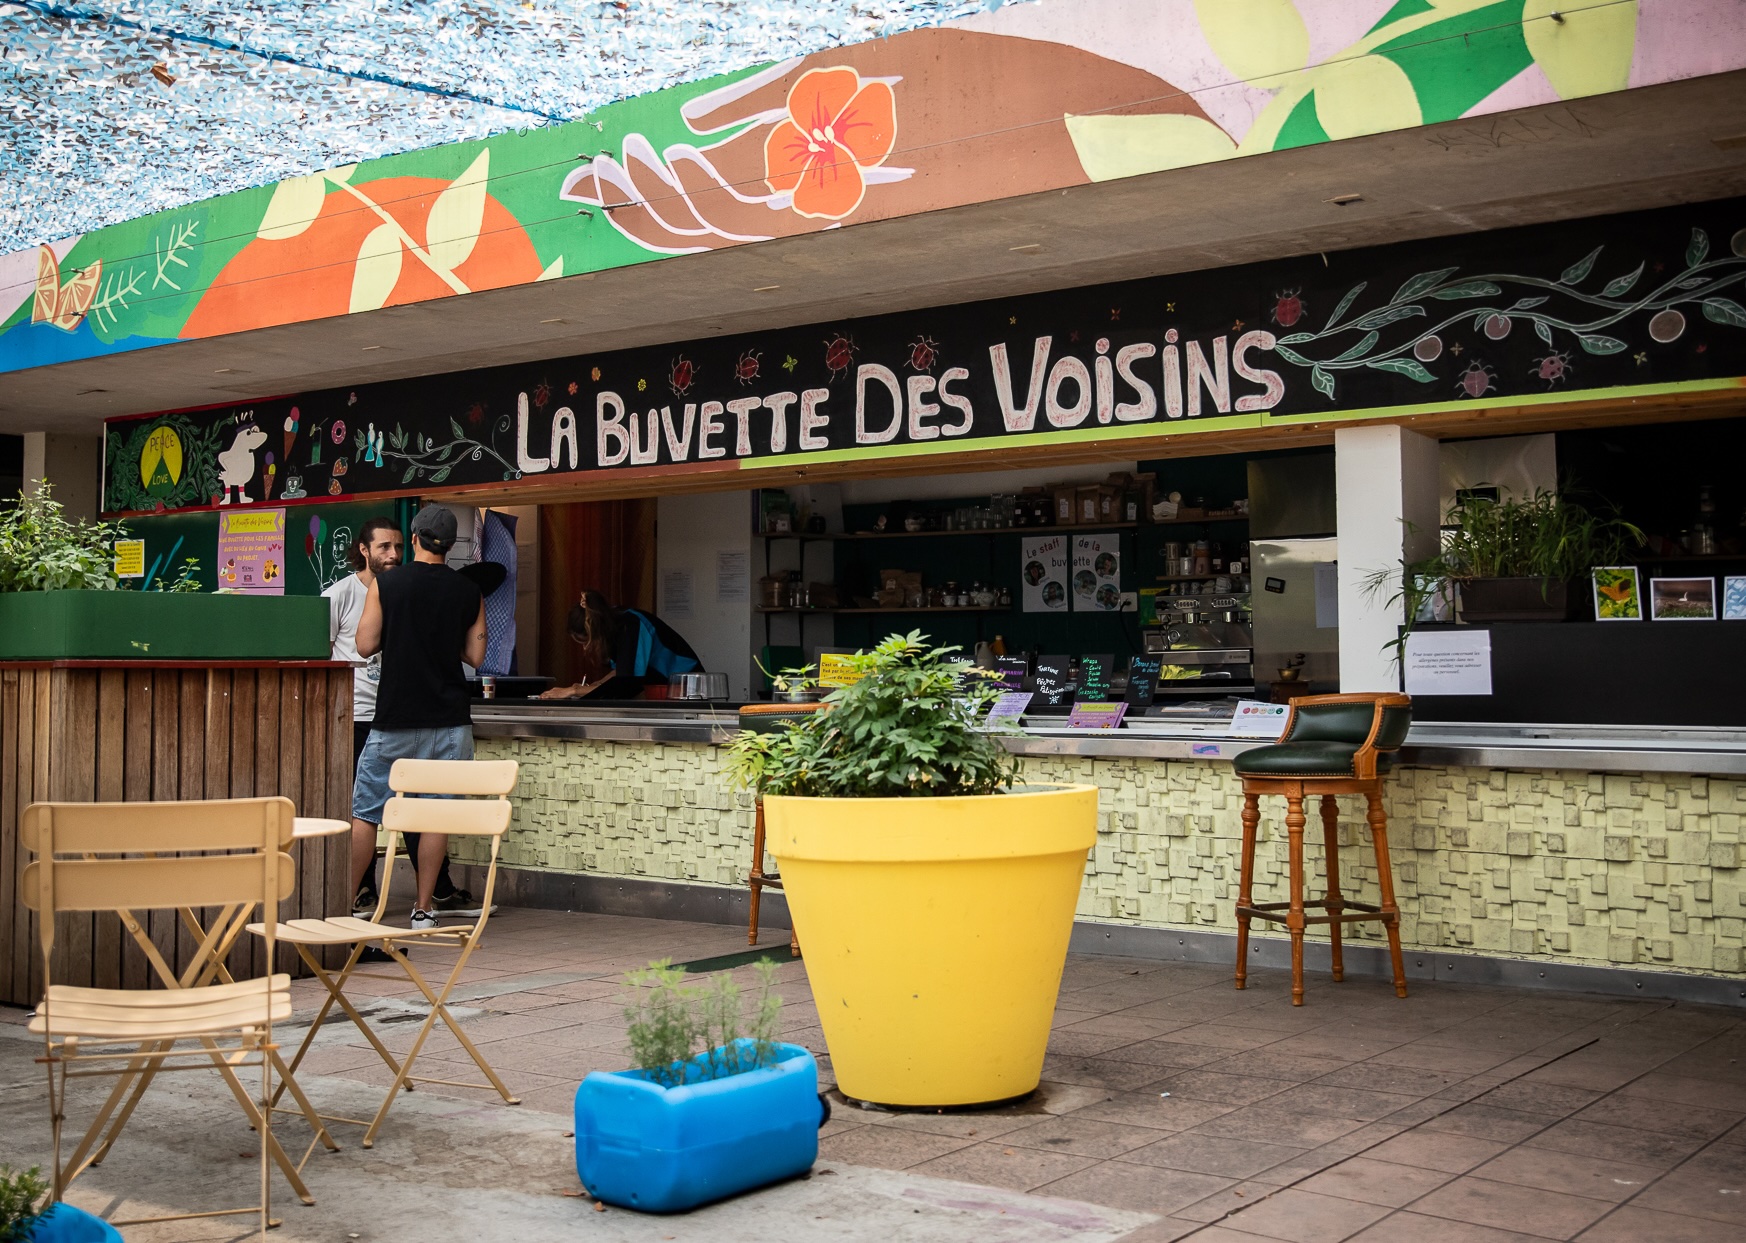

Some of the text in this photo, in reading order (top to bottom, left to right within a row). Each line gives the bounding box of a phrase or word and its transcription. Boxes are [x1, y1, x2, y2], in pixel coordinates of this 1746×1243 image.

[596, 387, 830, 467] BUVETTE
[855, 363, 974, 444] DES
[150, 434, 174, 453] PEACE
[152, 474, 168, 485] LOVE
[1026, 538, 1101, 559] Le staff de la
